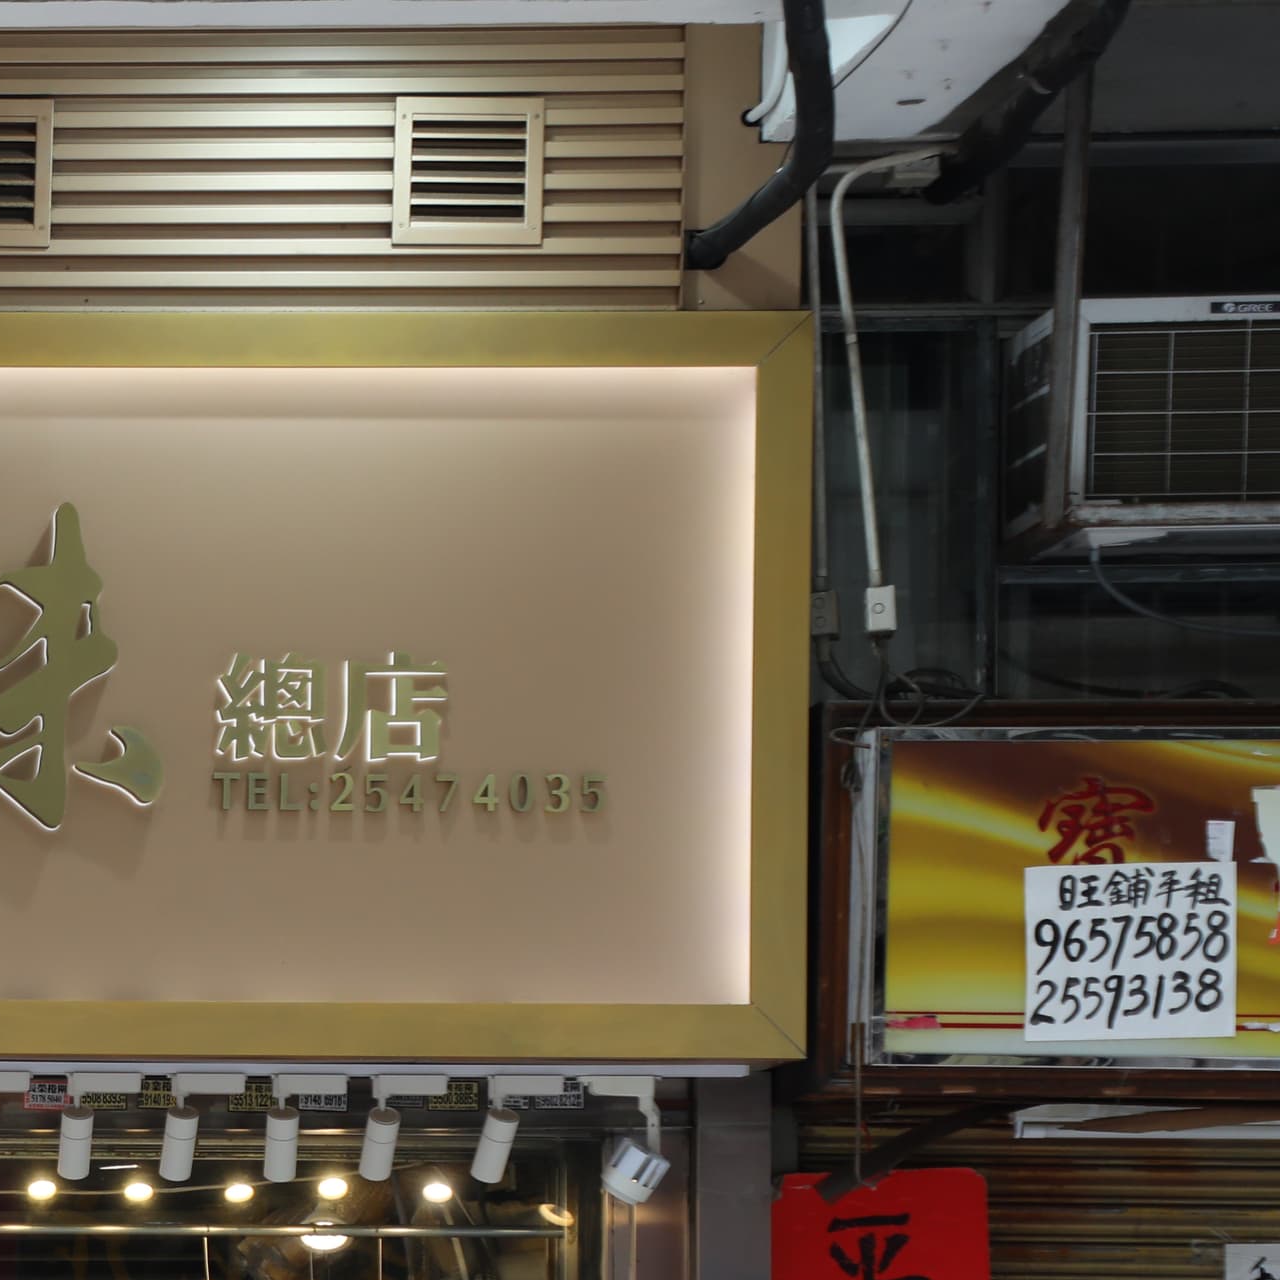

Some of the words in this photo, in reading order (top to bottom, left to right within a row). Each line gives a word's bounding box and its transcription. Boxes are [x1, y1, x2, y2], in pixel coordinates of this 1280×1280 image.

[1238, 303, 1273, 312] GREE
[215, 652, 449, 762] 總店
[213, 771, 608, 814] TEL:25474035
[1033, 909, 1230, 976] 96575858
[1030, 968, 1224, 1030] 25593138
